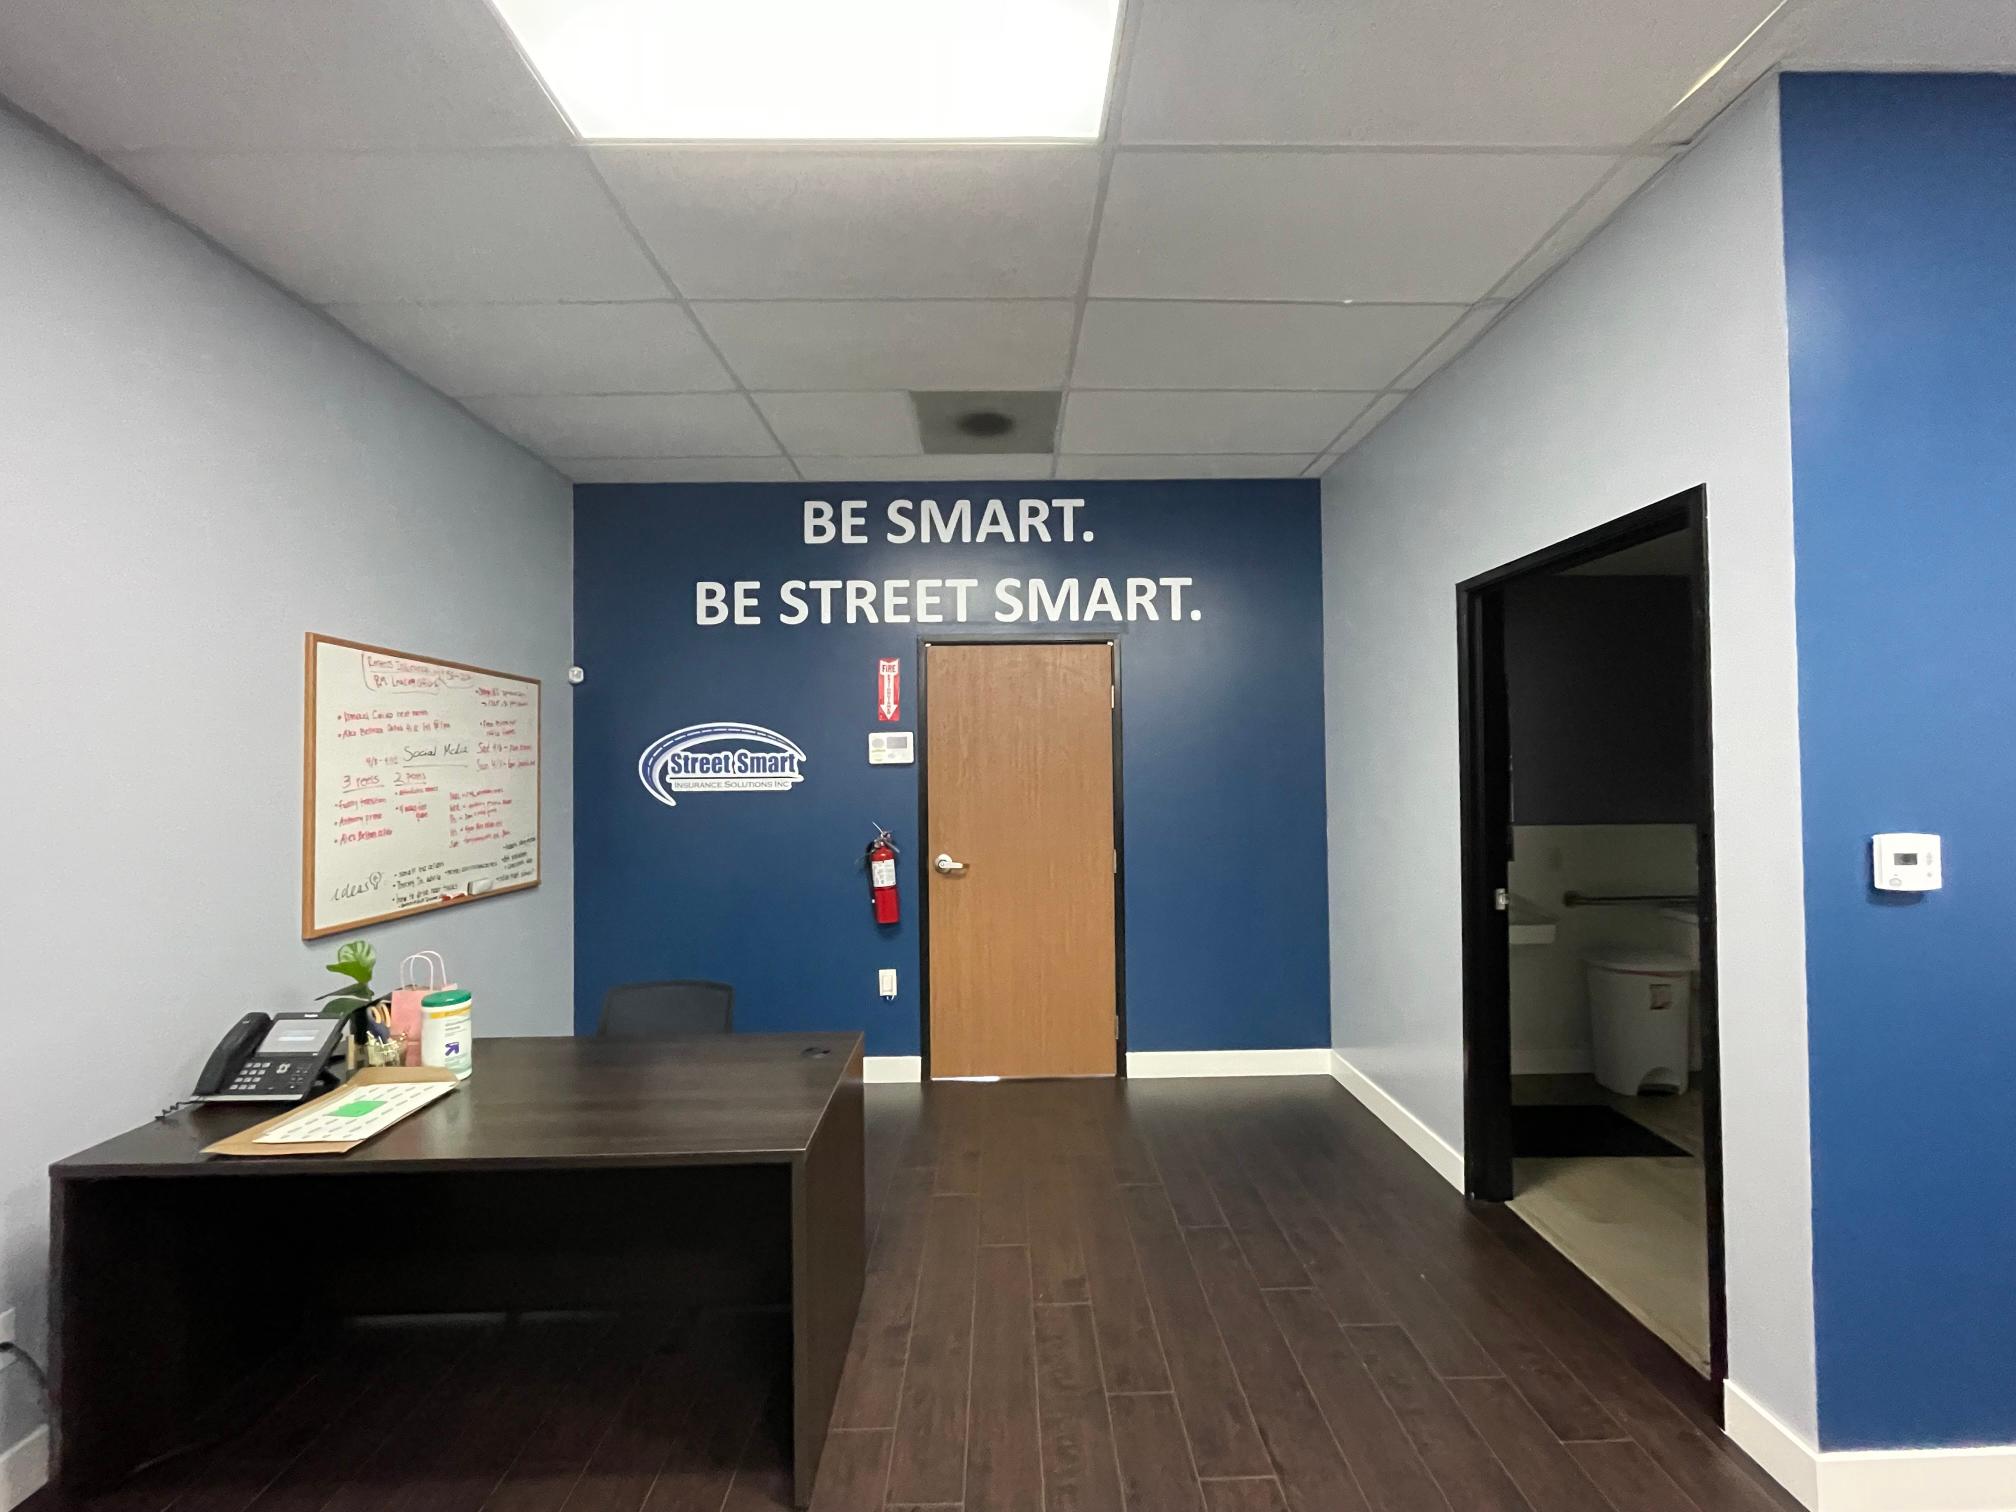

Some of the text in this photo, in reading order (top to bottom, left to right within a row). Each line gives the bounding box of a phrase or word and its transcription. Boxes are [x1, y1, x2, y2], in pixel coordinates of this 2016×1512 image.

[805, 499, 1093, 543] BE SMART.
[697, 578, 1201, 624] BE STREET SMART.
[882, 664, 896, 673] FIRE
[670, 752, 796, 774] Street Smart
[675, 780, 789, 789] INSURANCE SOLUTIONS INC
